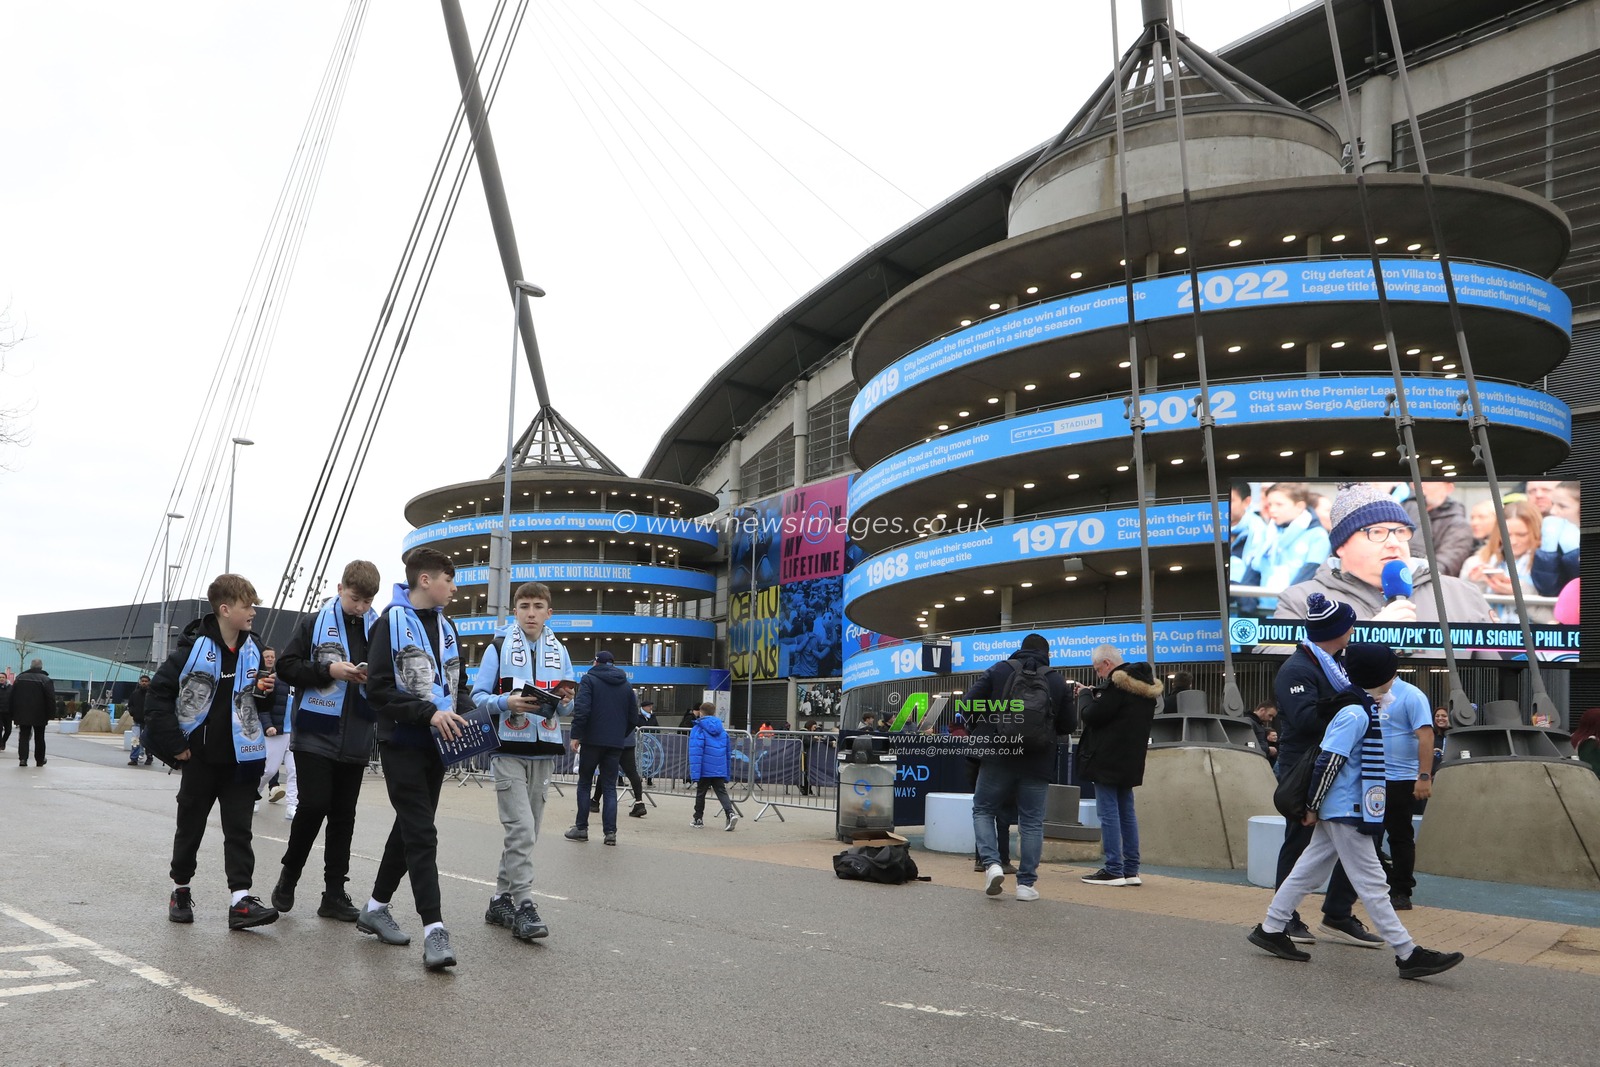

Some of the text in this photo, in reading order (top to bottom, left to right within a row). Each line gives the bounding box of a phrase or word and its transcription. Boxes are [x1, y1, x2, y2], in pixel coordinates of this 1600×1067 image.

[1301, 270, 1326, 282] City
[1328, 269, 1365, 279] defeat
[1367, 269, 1399, 279] Aton
[1401, 269, 1425, 279] Villa
[1426, 271, 1437, 280] to
[1439, 272, 1469, 283] scure
[1470, 273, 1485, 284] the
[1177, 270, 1289, 309] 2022
[1302, 283, 1344, 295] League
[1346, 281, 1369, 292] title
[1371, 281, 1421, 294] flowing
[1422, 284, 1459, 294] anotr
[1461, 285, 1498, 300] dramatic
[1519, 295, 1527, 304] of
[903, 361, 916, 373] City
[916, 349, 943, 366] become
[944, 340, 957, 353] the
[957, 334, 975, 348] first
[975, 325, 1001, 342] men's
[1002, 318, 1022, 333] side
[1023, 316, 1034, 326] to
[1035, 309, 1054, 323] win
[1055, 306, 1068, 318] all
[1070, 302, 1092, 315] four
[904, 316, 1083, 383] trophies available to them in a single season
[864, 367, 900, 411] 2019
[1249, 390, 1275, 402] City
[1276, 389, 1299, 399] win
[1300, 387, 1321, 398] the
[1323, 385, 1369, 397] Premier
[1371, 385, 1410, 398] Leage
[1412, 386, 1427, 396] for
[1428, 386, 1445, 397] the
[1446, 387, 1465, 398] first
[1486, 391, 1504, 402] with
[1505, 393, 1517, 404] the
[1249, 403, 1275, 414] that
[1277, 402, 1302, 412] saw
[1305, 399, 1343, 412] Sergio
[1345, 398, 1386, 412] Agüero
[1389, 400, 1417, 409] scre
[1419, 401, 1432, 410] an
[1433, 399, 1461, 410] iconic
[1482, 403, 1490, 413] in
[1490, 404, 1514, 416] added
[1013, 417, 1097, 440] ETIHAD STADIUM
[907, 453, 924, 465] Road
[924, 450, 933, 458] as
[933, 445, 949, 455] City
[949, 438, 972, 451] move
[972, 434, 990, 444] into
[915, 461, 930, 472] was
[929, 455, 947, 467] then
[947, 449, 974, 463] known
[428, 515, 614, 538] in my heart, withot a love of my own
[1117, 517, 1140, 528] City
[1146, 514, 1165, 525] win
[1167, 511, 1195, 523] their
[1012, 517, 1105, 554] 1970
[1176, 525, 1200, 537] Cup
[784, 535, 803, 559] MY
[914, 536, 993, 561] City win their second
[783, 550, 840, 580] LIFETIME
[866, 552, 909, 587] 1968
[914, 552, 972, 571] ever league title
[455, 572, 464, 583] OF
[464, 570, 477, 582] THE
[516, 566, 538, 579] MAN,
[539, 565, 565, 578] WE'RE
[566, 565, 582, 578] NOT
[583, 566, 612, 579] REALLY
[612, 566, 632, 580] HERE
[460, 621, 486, 632] CITY
[1258, 625, 1293, 640] OTOUT
[1429, 628, 1445, 645] TO
[1449, 629, 1473, 645] WIN
[1475, 629, 1485, 645] A
[1486, 630, 1532, 646] SIGNE
[1536, 631, 1566, 647] PHIL
[973, 639, 1022, 652] City defeat
[1057, 634, 1117, 646] Wanderers
[1119, 633, 1130, 643] in
[1131, 632, 1147, 642] the
[1152, 631, 1168, 641] FA
[1170, 630, 1194, 642] Cup
[1196, 629, 1223, 640] final
[932, 647, 942, 668] V
[973, 652, 1010, 663] becomin
[1130, 643, 1204, 656] sid to win a
[1290, 685, 1304, 695] HH
[307, 697, 336, 708] GREALISH
